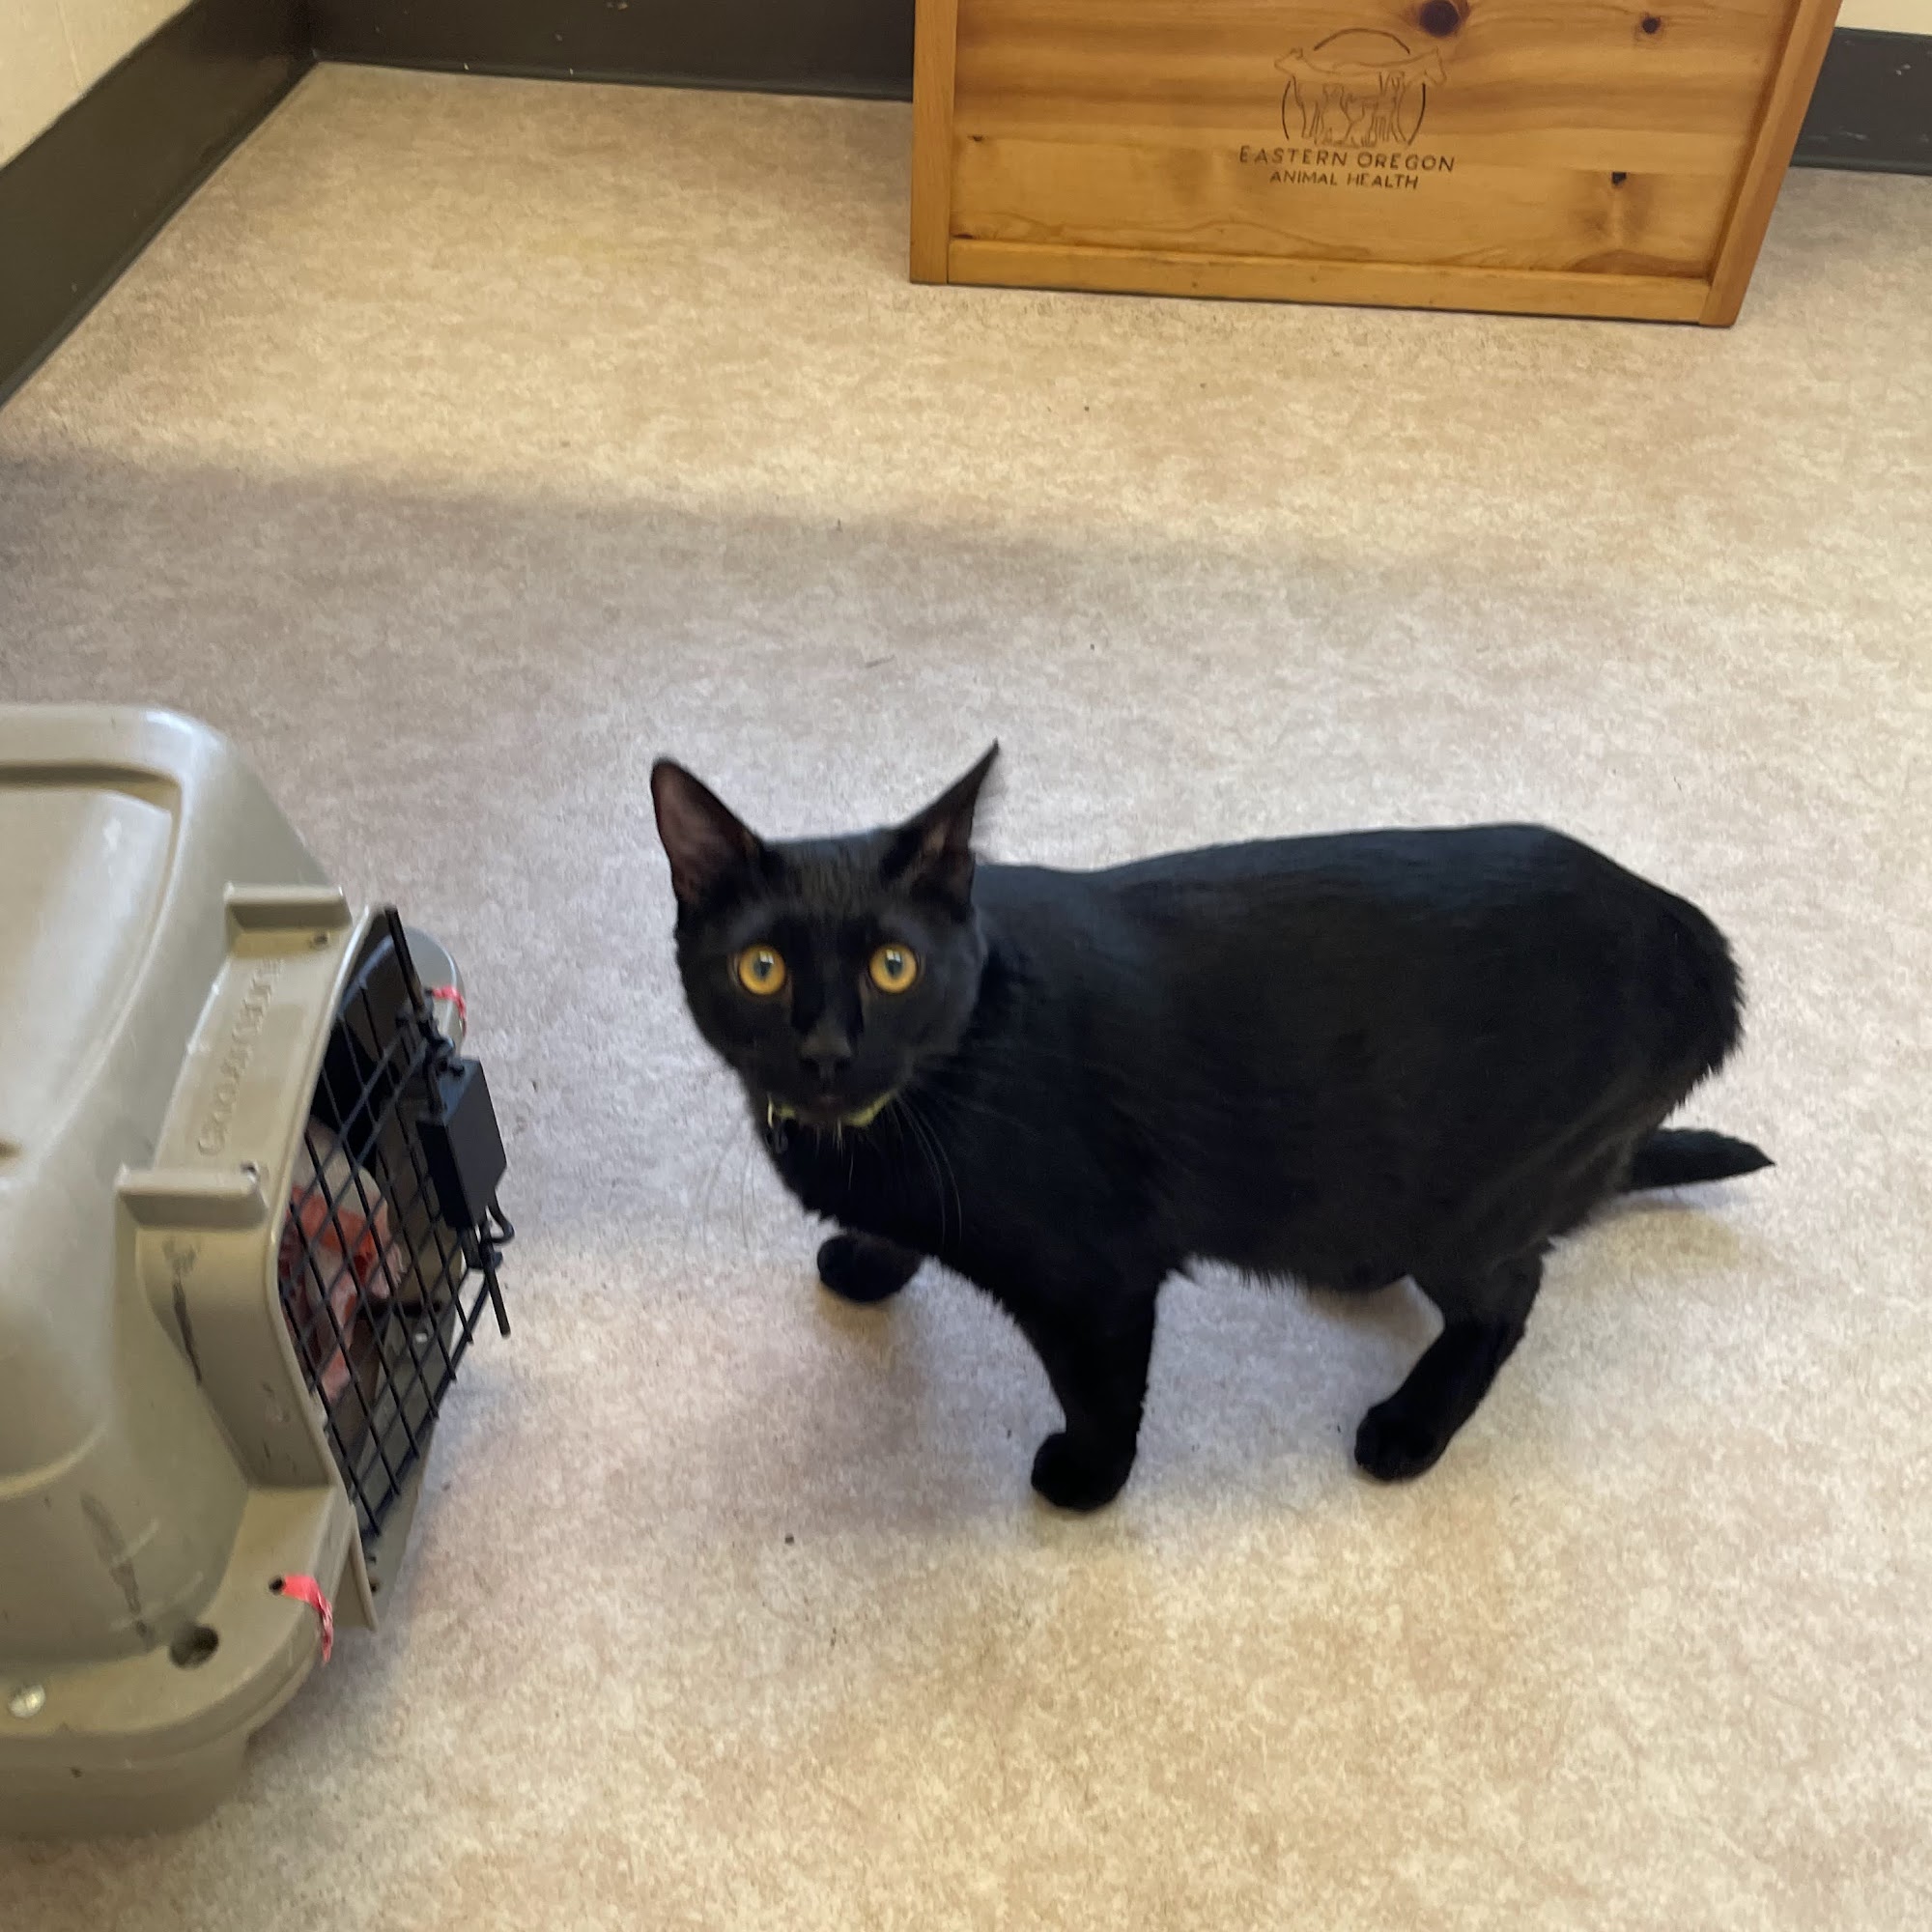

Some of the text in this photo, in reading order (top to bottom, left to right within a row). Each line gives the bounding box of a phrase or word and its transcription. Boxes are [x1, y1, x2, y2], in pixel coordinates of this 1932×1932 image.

[1239, 145, 1455, 172] EASTERN OREGON
[1269, 170, 1419, 189] ANIMAL HEALTH
